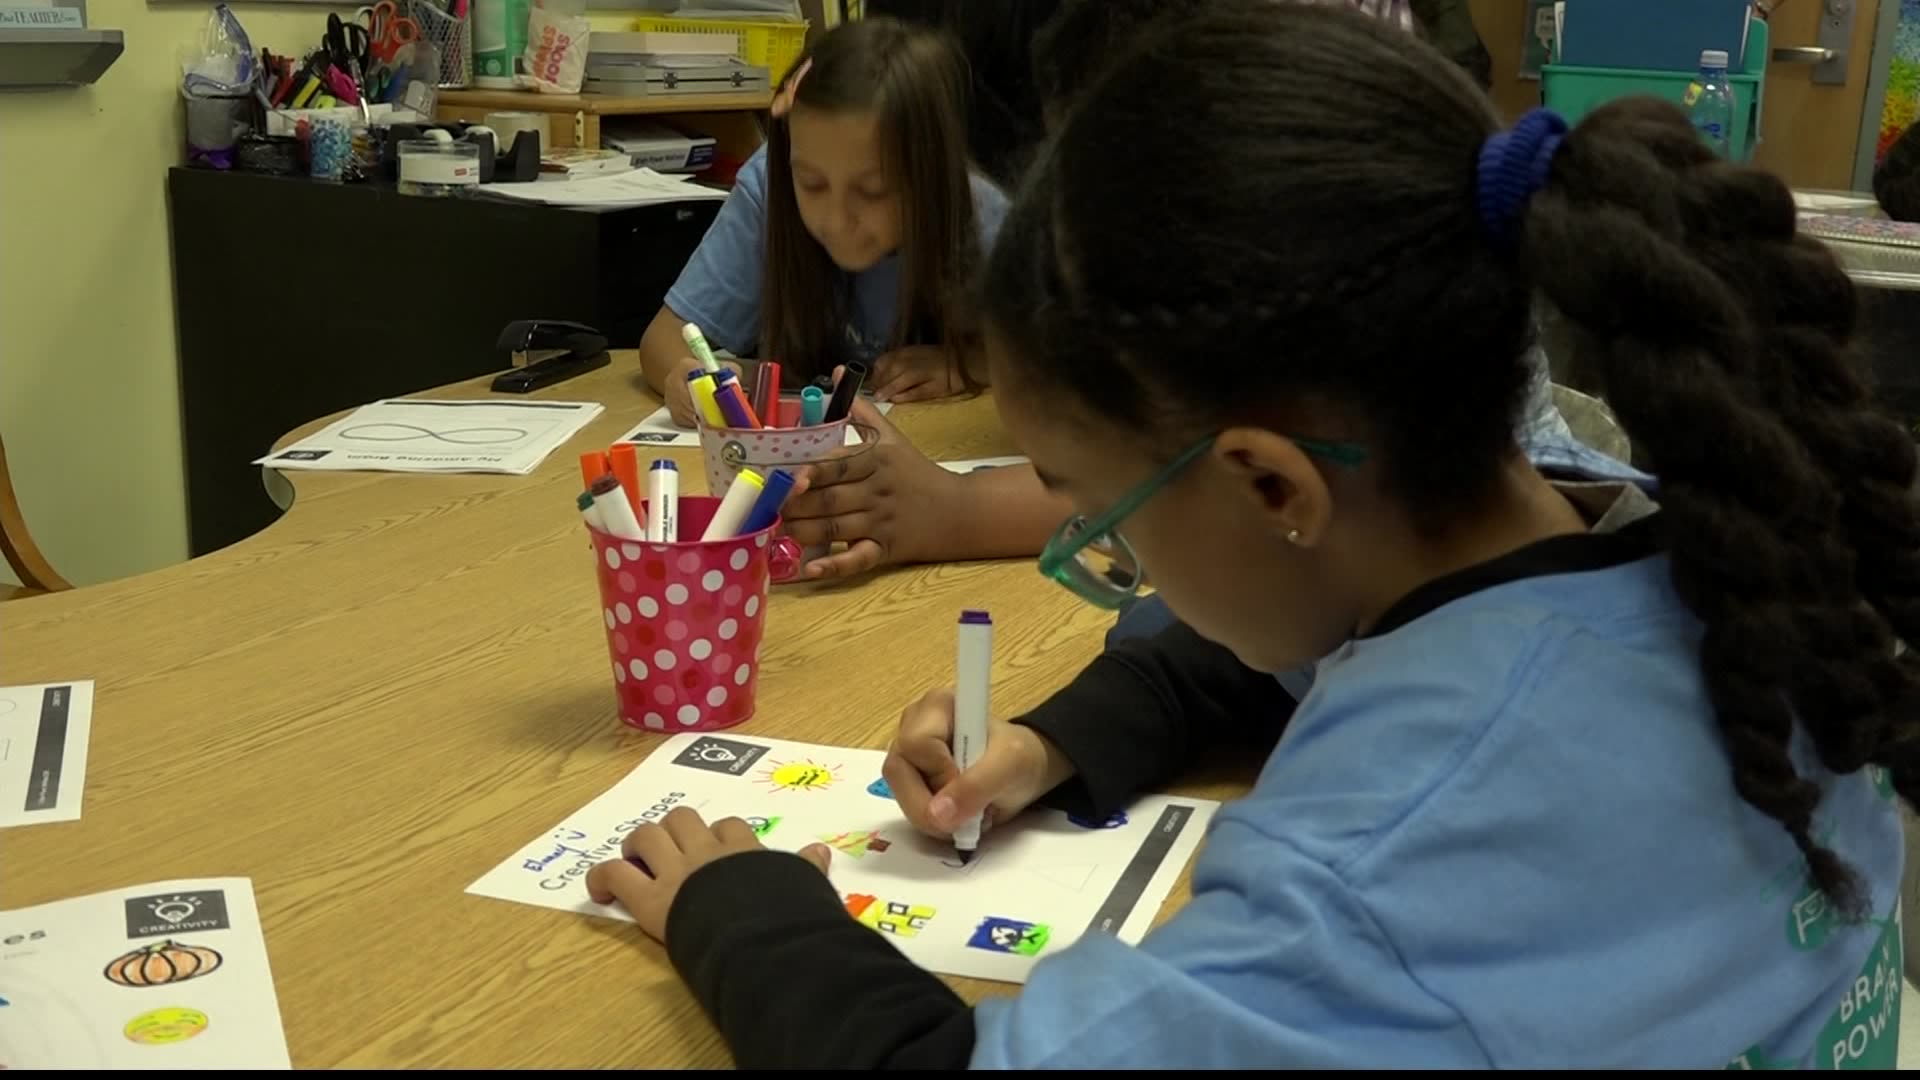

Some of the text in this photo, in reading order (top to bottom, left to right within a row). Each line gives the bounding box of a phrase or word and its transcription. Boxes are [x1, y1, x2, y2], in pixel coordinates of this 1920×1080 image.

[539, 791, 686, 891] Creative Shapes
[138, 918, 219, 935] CREATIVITY
[1832, 967, 1899, 1070] POWR
